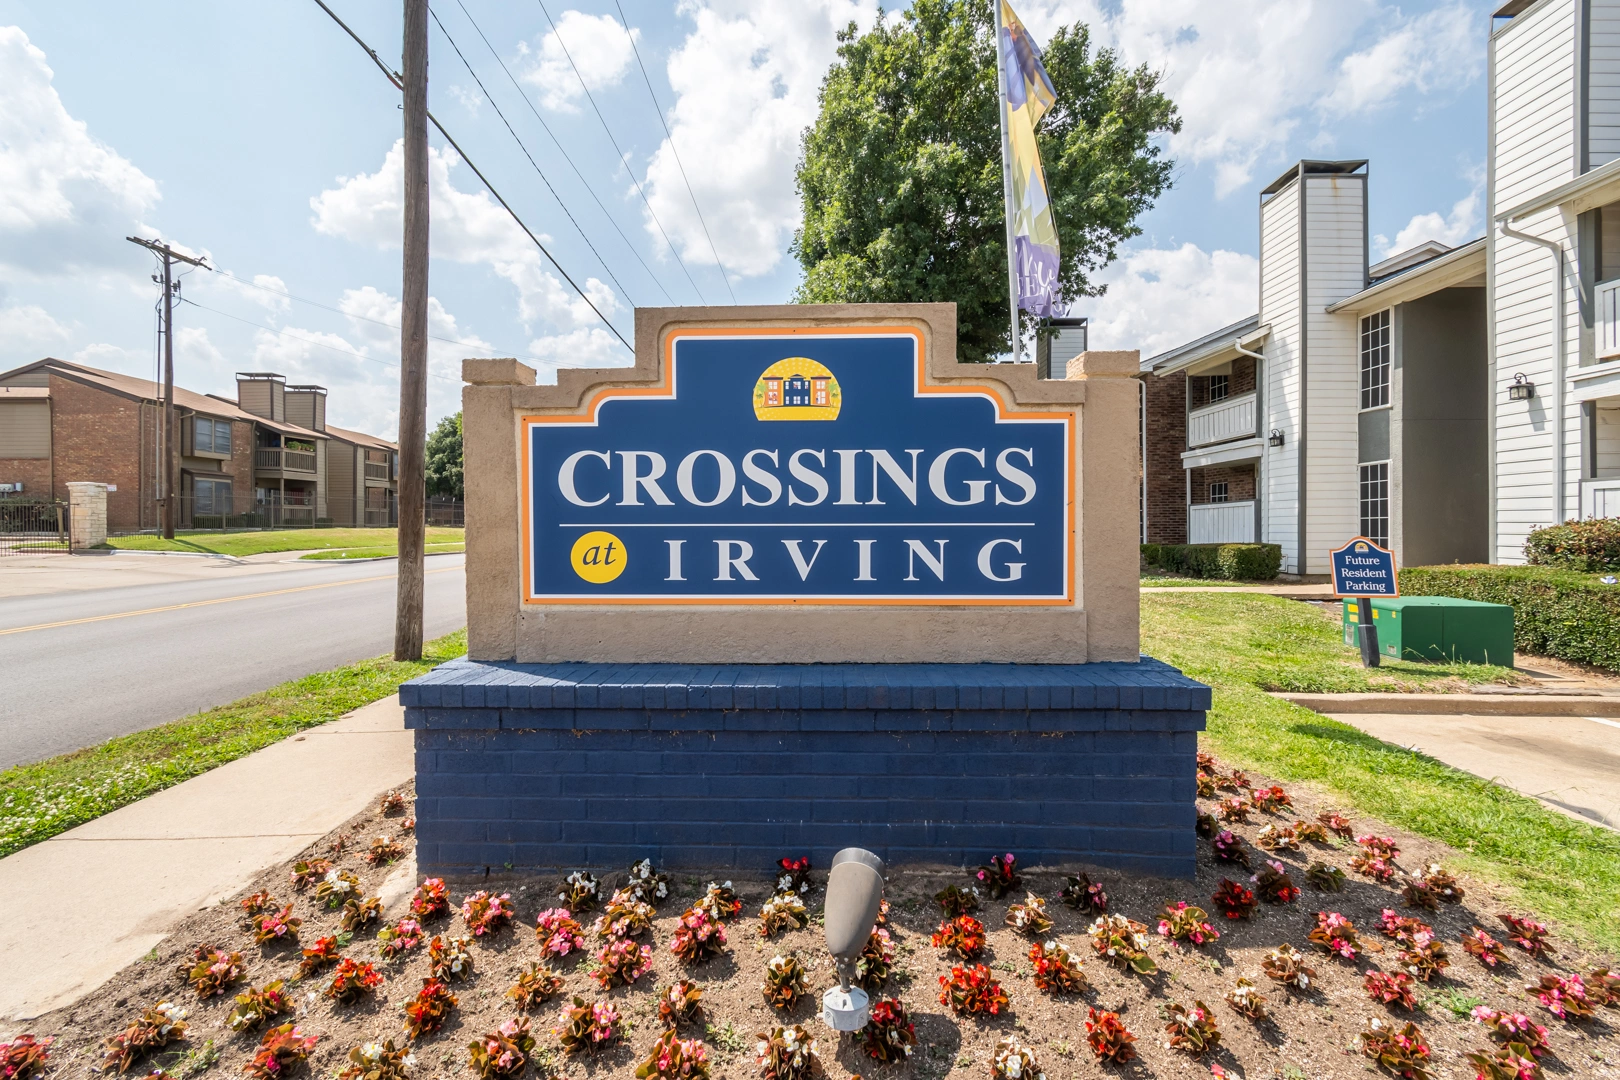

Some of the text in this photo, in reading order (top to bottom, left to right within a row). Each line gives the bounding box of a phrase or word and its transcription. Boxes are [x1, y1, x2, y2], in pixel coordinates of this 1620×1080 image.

[557, 447, 1037, 507] CROSSINGS
[581, 538, 1027, 582] at IRVING
[1345, 555, 1381, 565] Future
[1341, 567, 1387, 578] Resident
[1345, 580, 1387, 593] Parking
